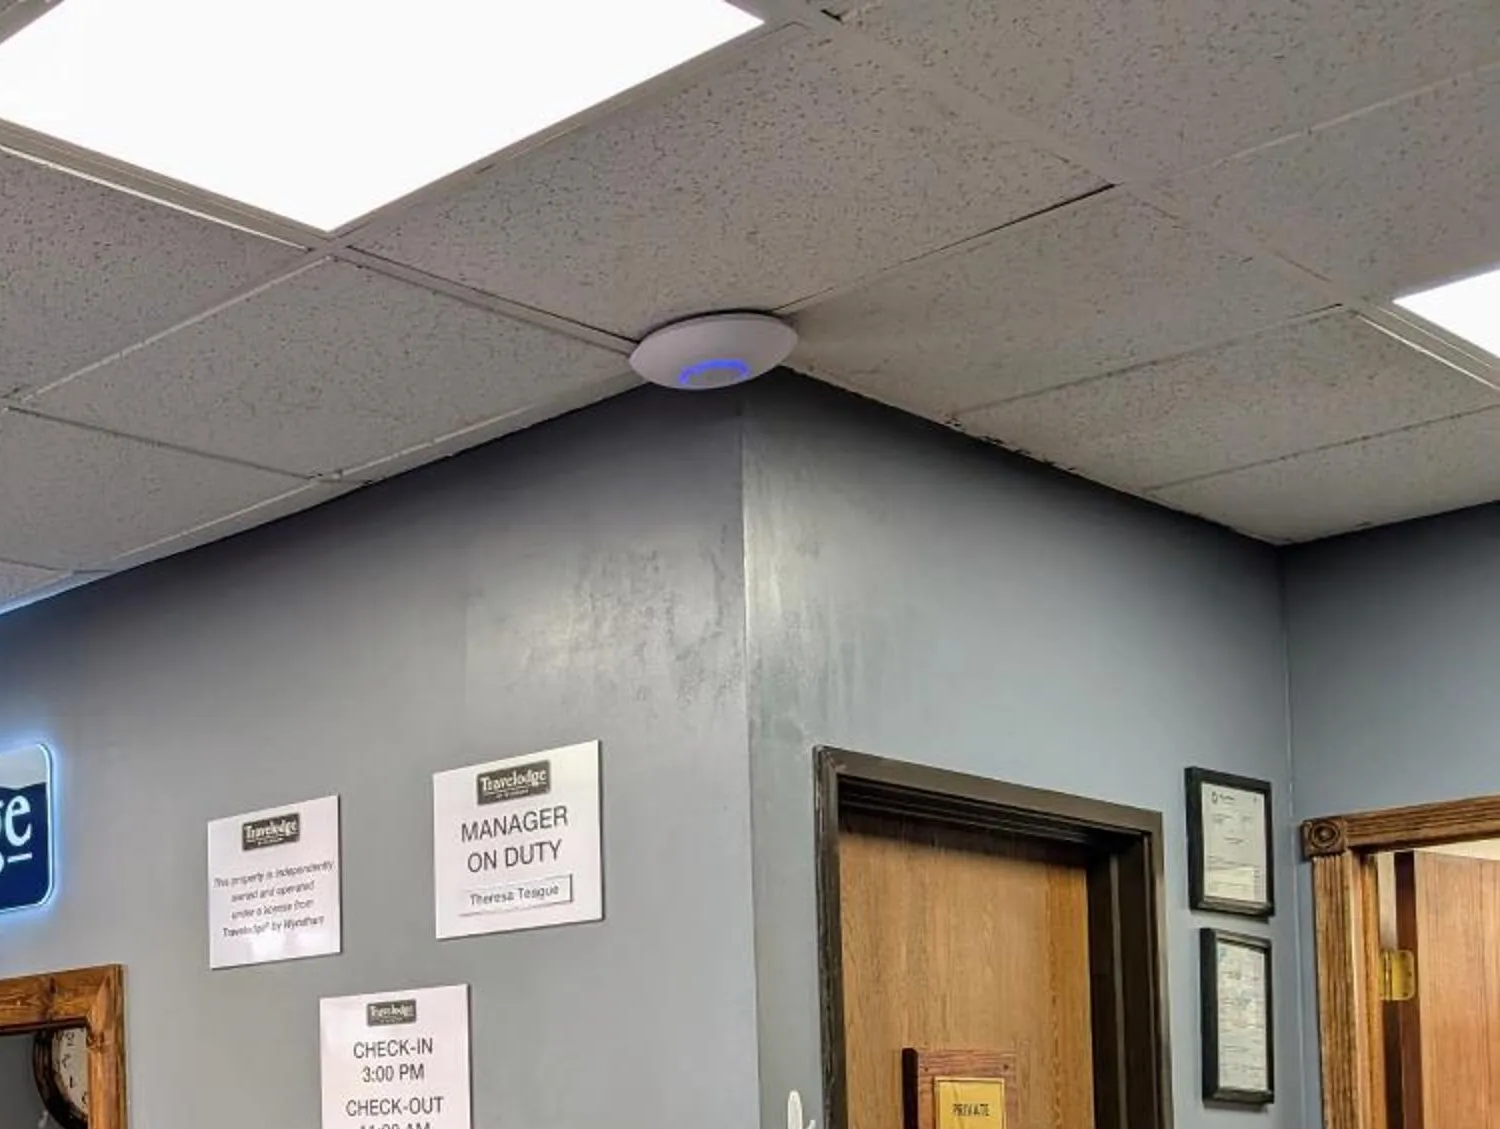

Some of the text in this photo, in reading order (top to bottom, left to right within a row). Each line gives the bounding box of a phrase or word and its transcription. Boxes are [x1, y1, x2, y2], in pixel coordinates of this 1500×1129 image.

[461, 805, 569, 843] MANAGER
[467, 838, 563, 873] ON DUTY
[469, 883, 560, 907] Theresa Teague
[353, 1037, 434, 1059] CHECK-IN
[362, 1063, 425, 1083] 3:00 PM
[345, 1096, 444, 1117] CHECK-OUT
[952, 1103, 991, 1117] PRIVATE
